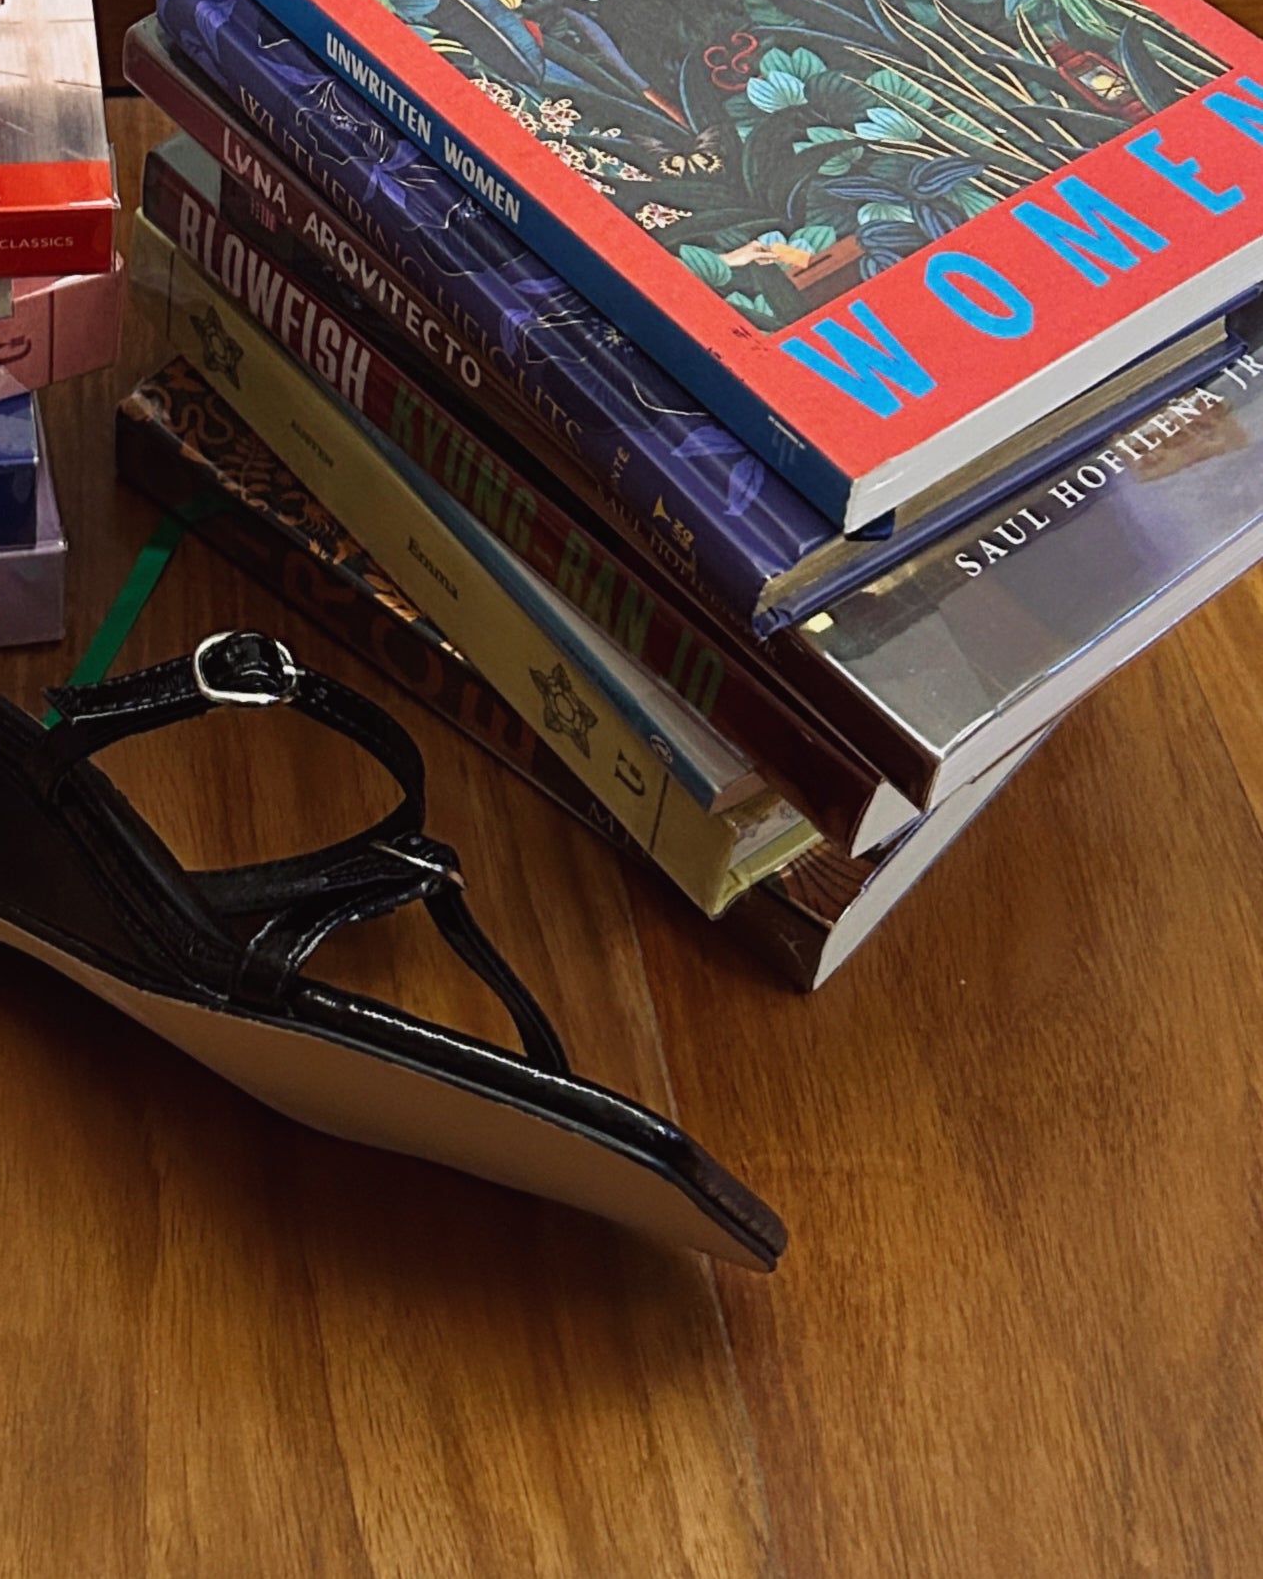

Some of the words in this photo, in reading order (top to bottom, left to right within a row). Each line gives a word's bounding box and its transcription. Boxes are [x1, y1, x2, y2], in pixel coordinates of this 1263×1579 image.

[325, 31, 433, 146] UNWRITTEN
[443, 136, 521, 225] WOMEN
[179, 192, 372, 412] BLOWFISH
[302, 211, 482, 388] ARQVITECTO
[407, 535, 458, 601] Emma
[954, 507, 1051, 578] SAUL
